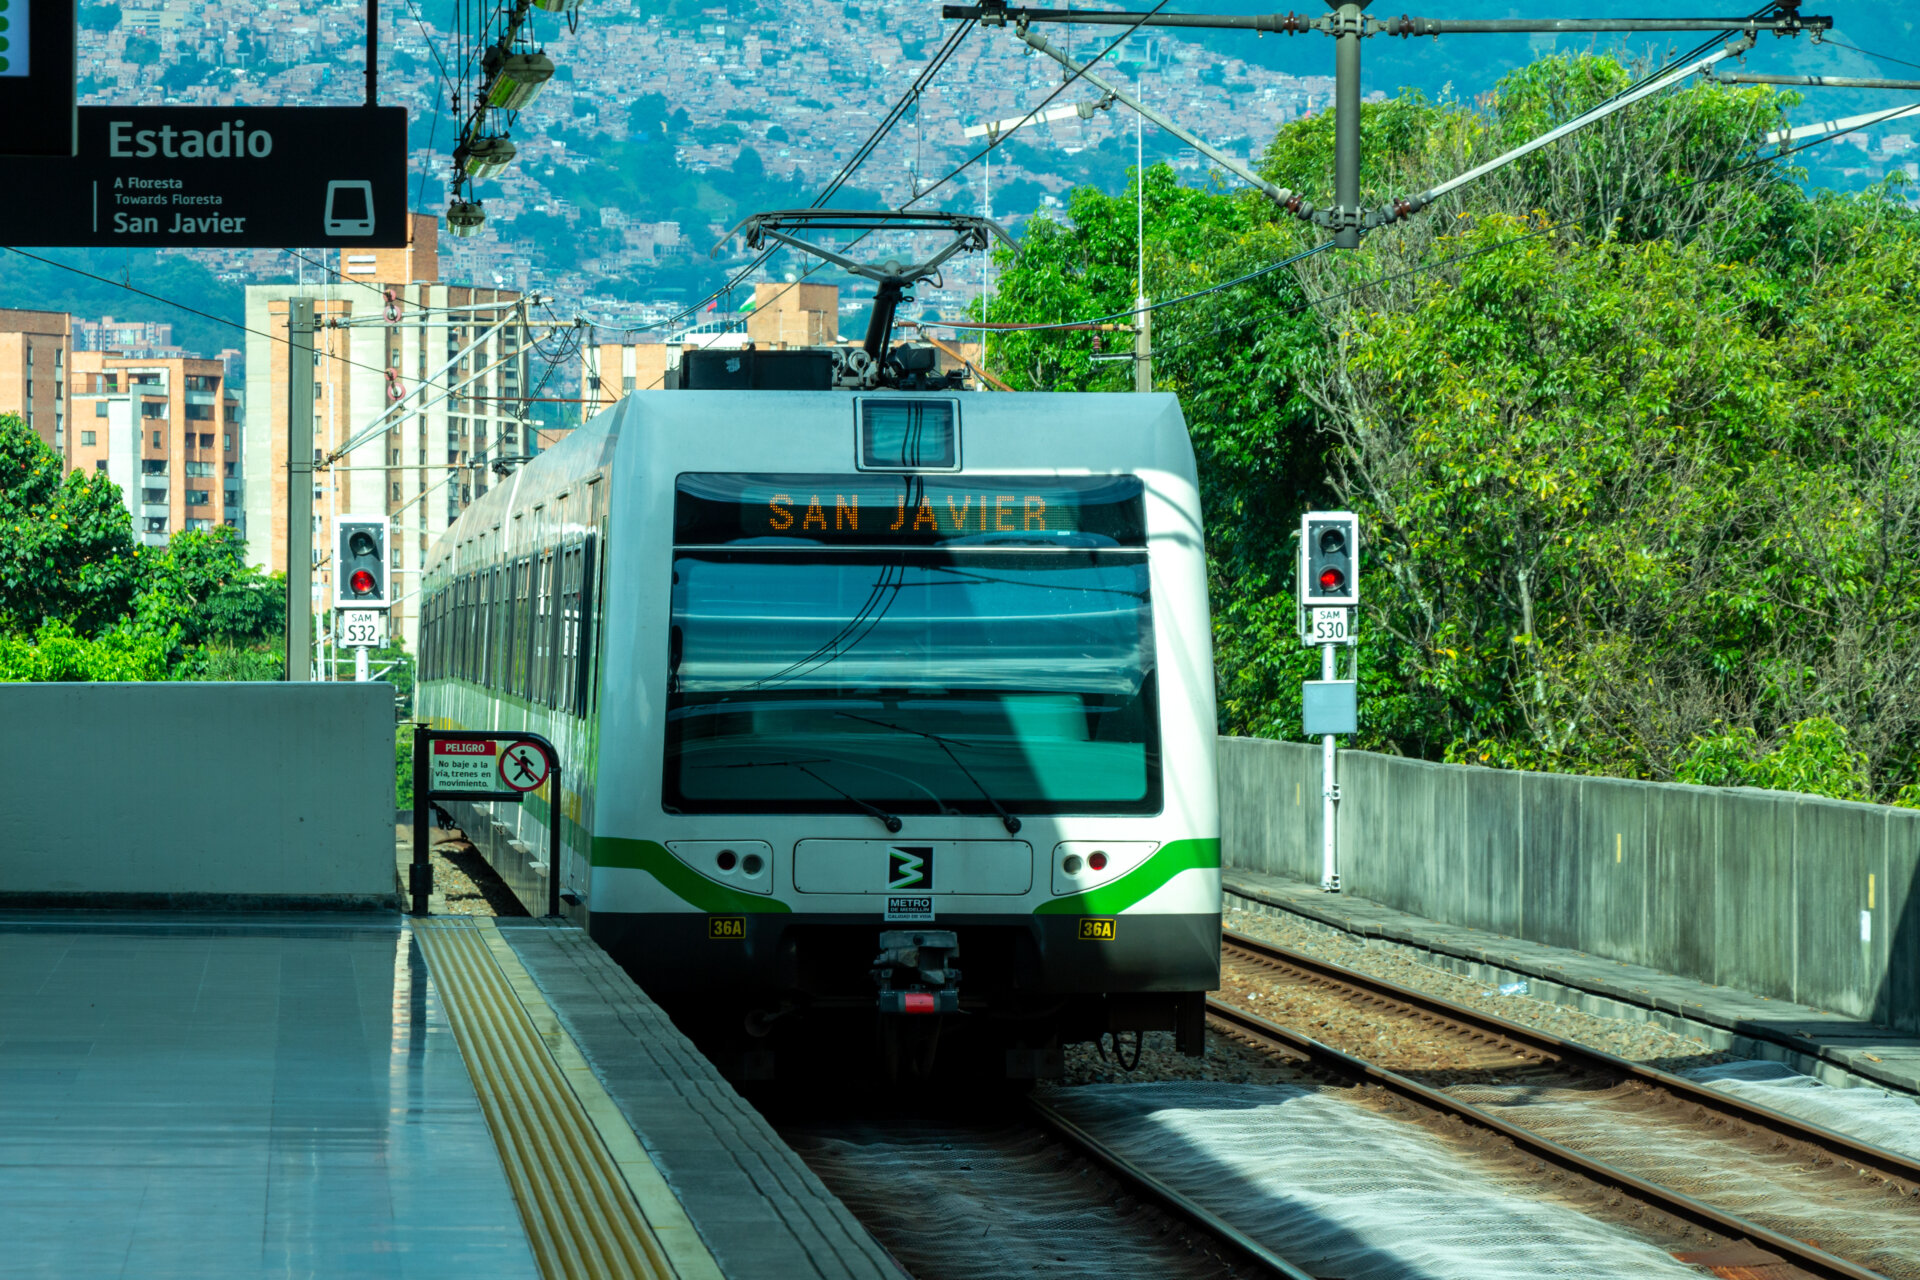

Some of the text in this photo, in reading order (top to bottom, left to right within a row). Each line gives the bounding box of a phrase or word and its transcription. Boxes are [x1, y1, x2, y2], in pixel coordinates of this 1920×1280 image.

[109, 120, 272, 158] Estadio
[113, 177, 183, 189] A Floresta
[115, 193, 223, 205] Towards Floresta
[113, 212, 246, 234] San Javier
[769, 494, 1046, 531] SAN JAVIER
[351, 614, 372, 622] SAM
[1320, 610, 1341, 619] SAM
[348, 625, 375, 641] S32
[1317, 621, 1344, 639] S30
[445, 743, 485, 753] PELIGRO
[438, 760, 449, 768] No
[452, 760, 470, 770] baje
[480, 760, 488, 768] la
[439, 779, 488, 787] movimiento.
[890, 899, 930, 907] METRO
[713, 920, 742, 935] 36A
[1083, 921, 1112, 937] 36A
